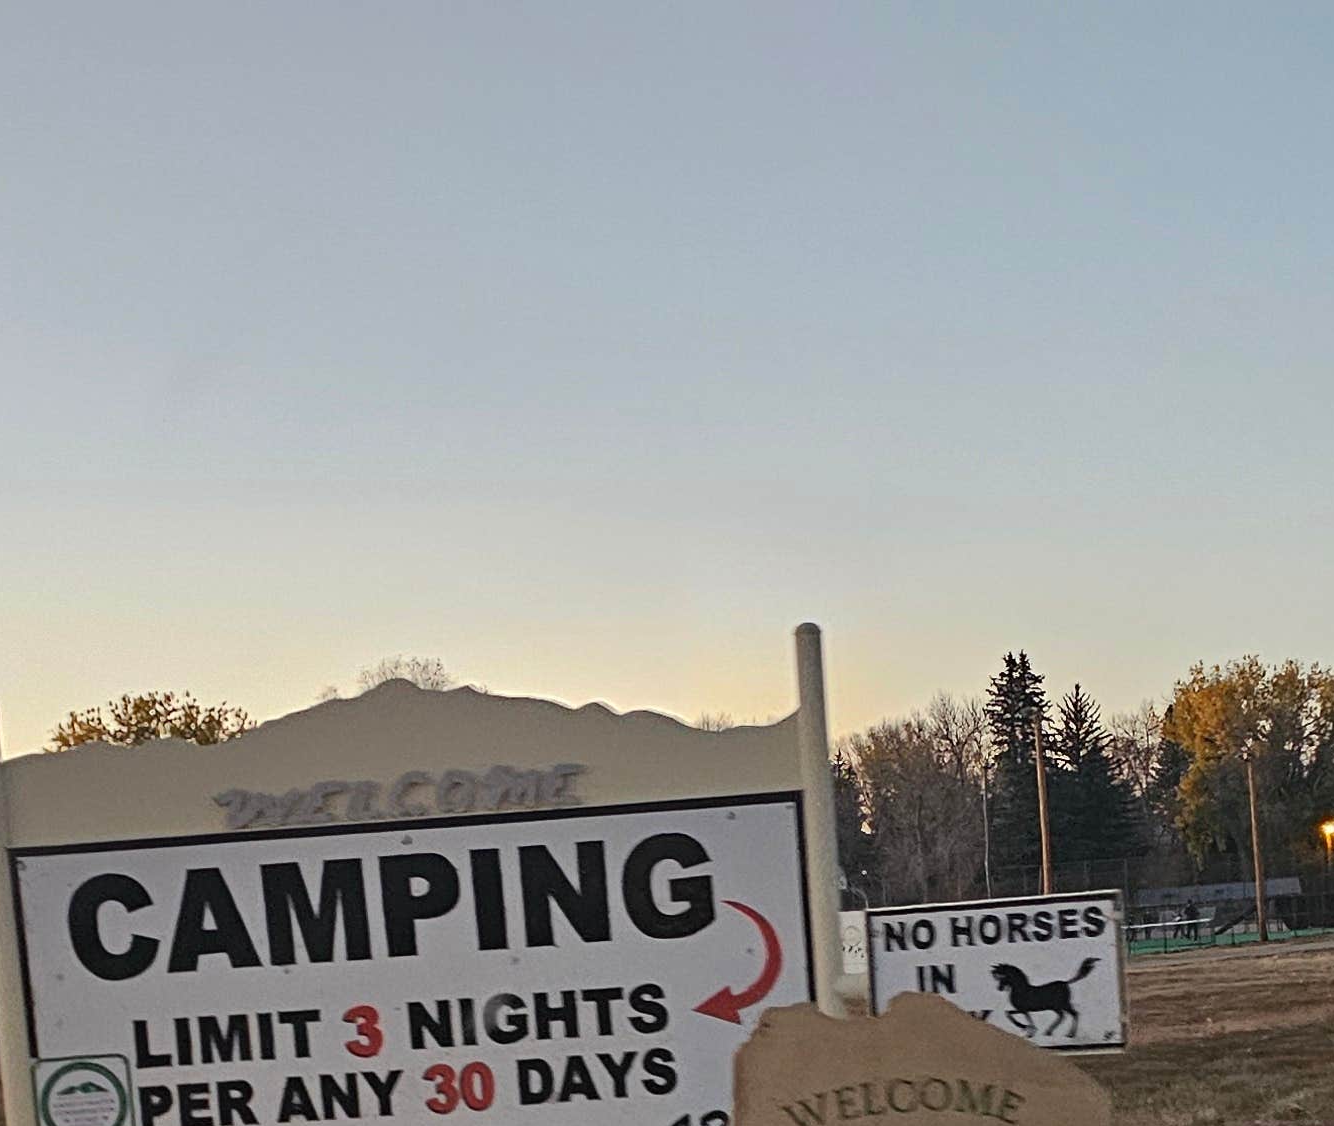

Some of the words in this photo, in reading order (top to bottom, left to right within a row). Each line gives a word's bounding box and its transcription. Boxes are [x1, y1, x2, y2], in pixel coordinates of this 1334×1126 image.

[213, 763, 588, 829] WELCOME
[68, 832, 715, 981] CAMPING
[882, 919, 937, 953] NO
[951, 906, 1106, 947] HORSES
[916, 964, 957, 994] IN
[132, 1009, 321, 1069] LIMIT
[342, 1005, 384, 1058] 3
[408, 983, 669, 1050] NIGHTS
[277, 1069, 404, 1123] ANY
[421, 1061, 495, 1114] 30
[516, 1047, 678, 1106] DAYS
